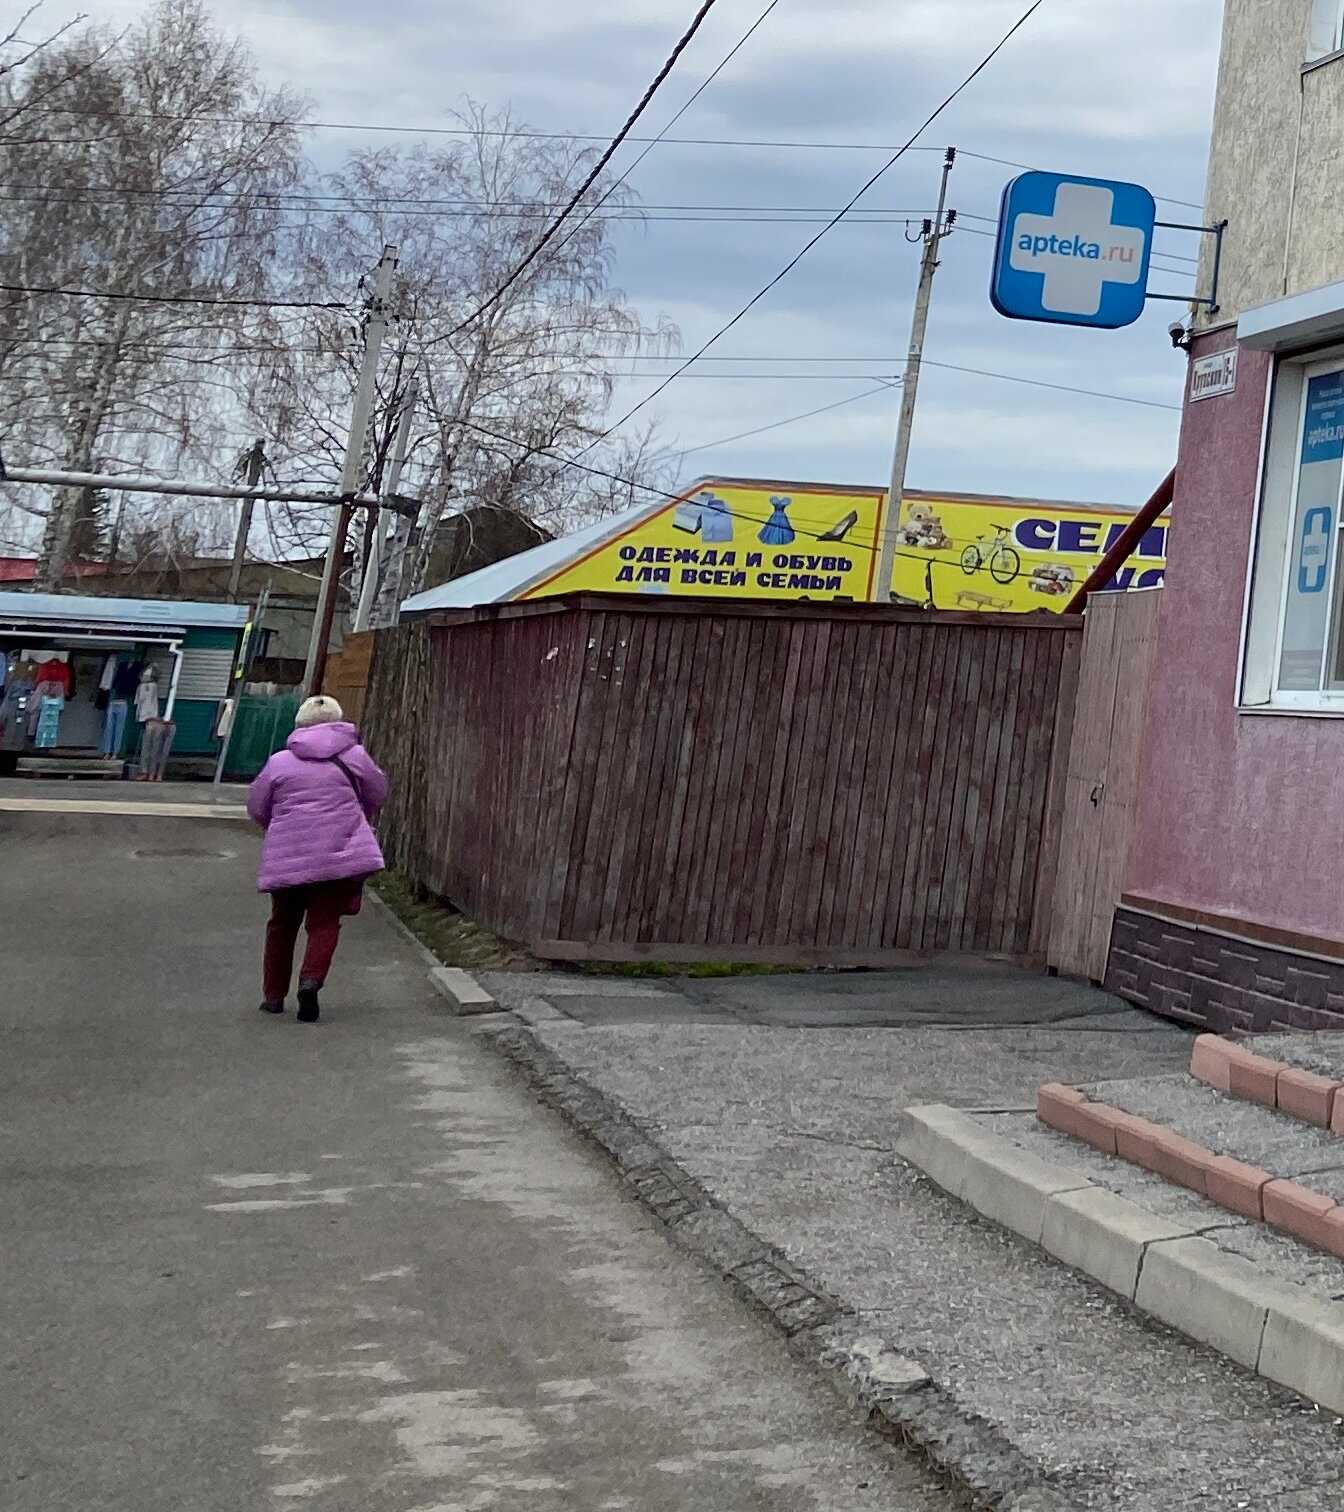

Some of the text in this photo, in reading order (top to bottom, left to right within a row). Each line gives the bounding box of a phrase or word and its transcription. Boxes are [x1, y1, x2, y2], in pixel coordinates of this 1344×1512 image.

[1017, 233, 1135, 263] apteka.ru
[618, 545, 853, 573] ОДЕЖДА И ОБУВЬ
[615, 565, 842, 591] ДЛЯ ВСЕЙ СЕМЬИ
